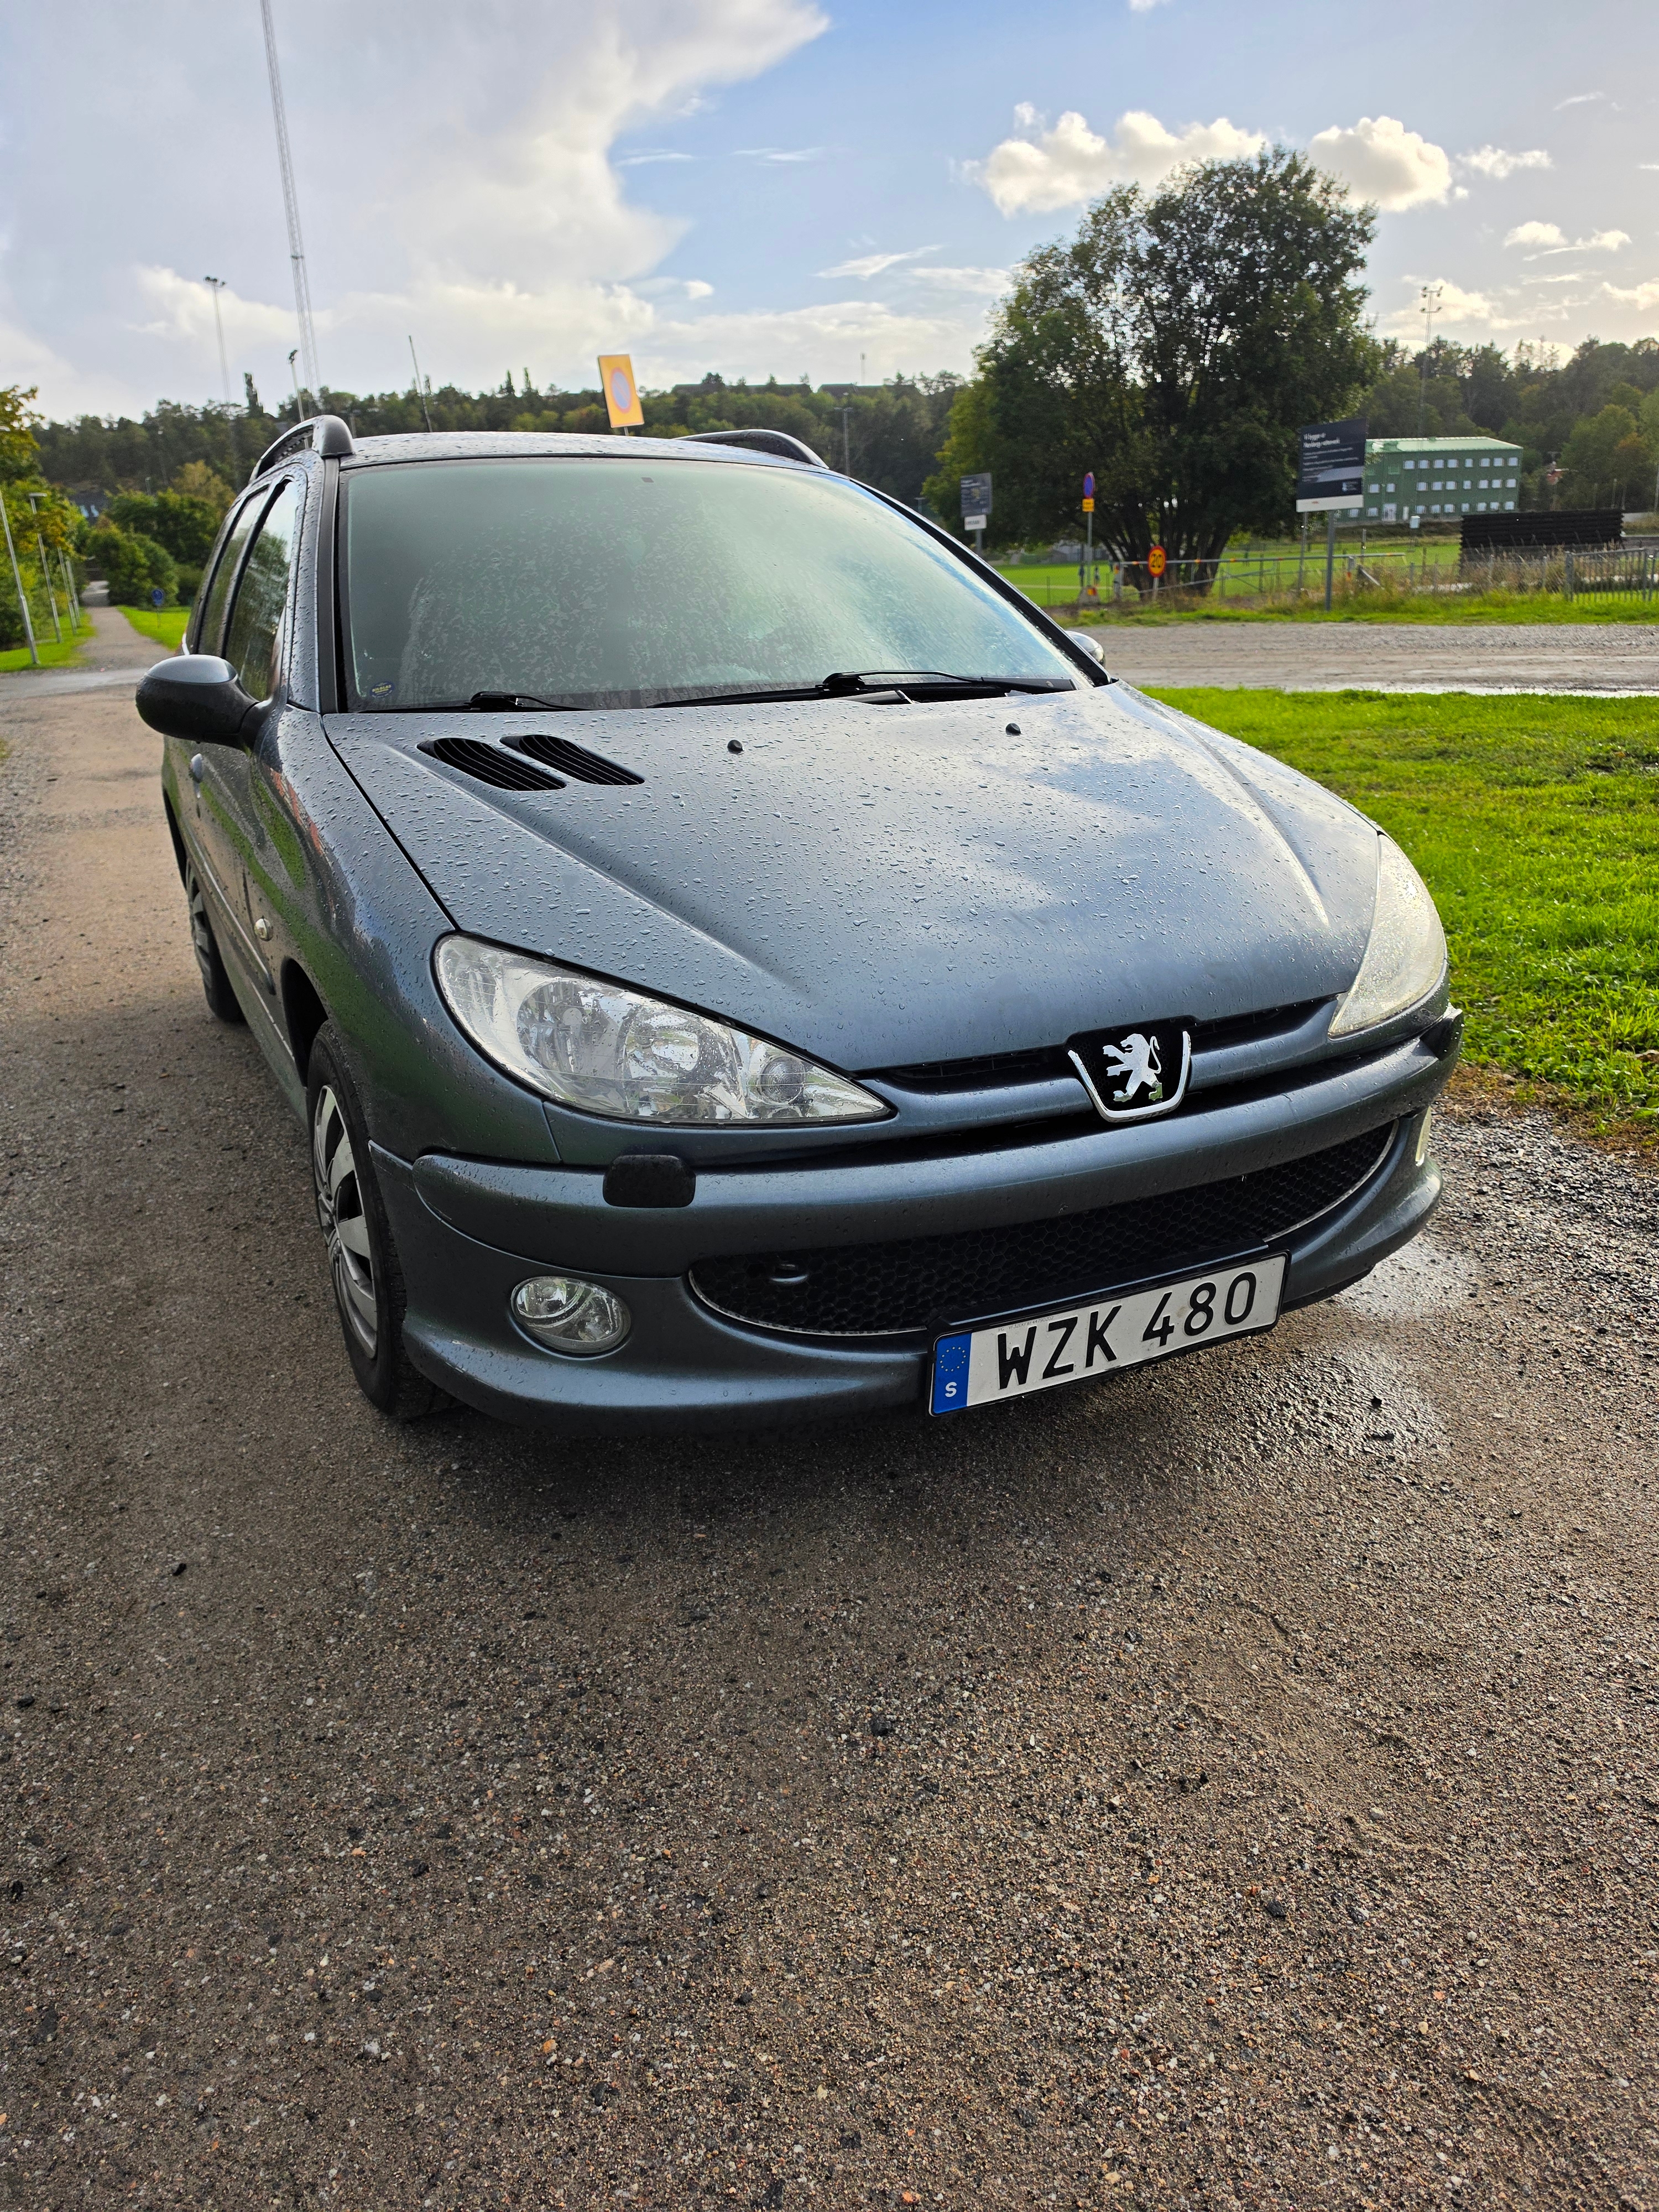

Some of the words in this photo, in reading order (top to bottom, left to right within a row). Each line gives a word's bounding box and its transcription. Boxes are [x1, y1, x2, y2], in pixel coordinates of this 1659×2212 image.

[997, 1305, 1122, 1390] WZK
[1142, 1271, 1257, 1347] 480
[944, 1381, 957, 1399] S
